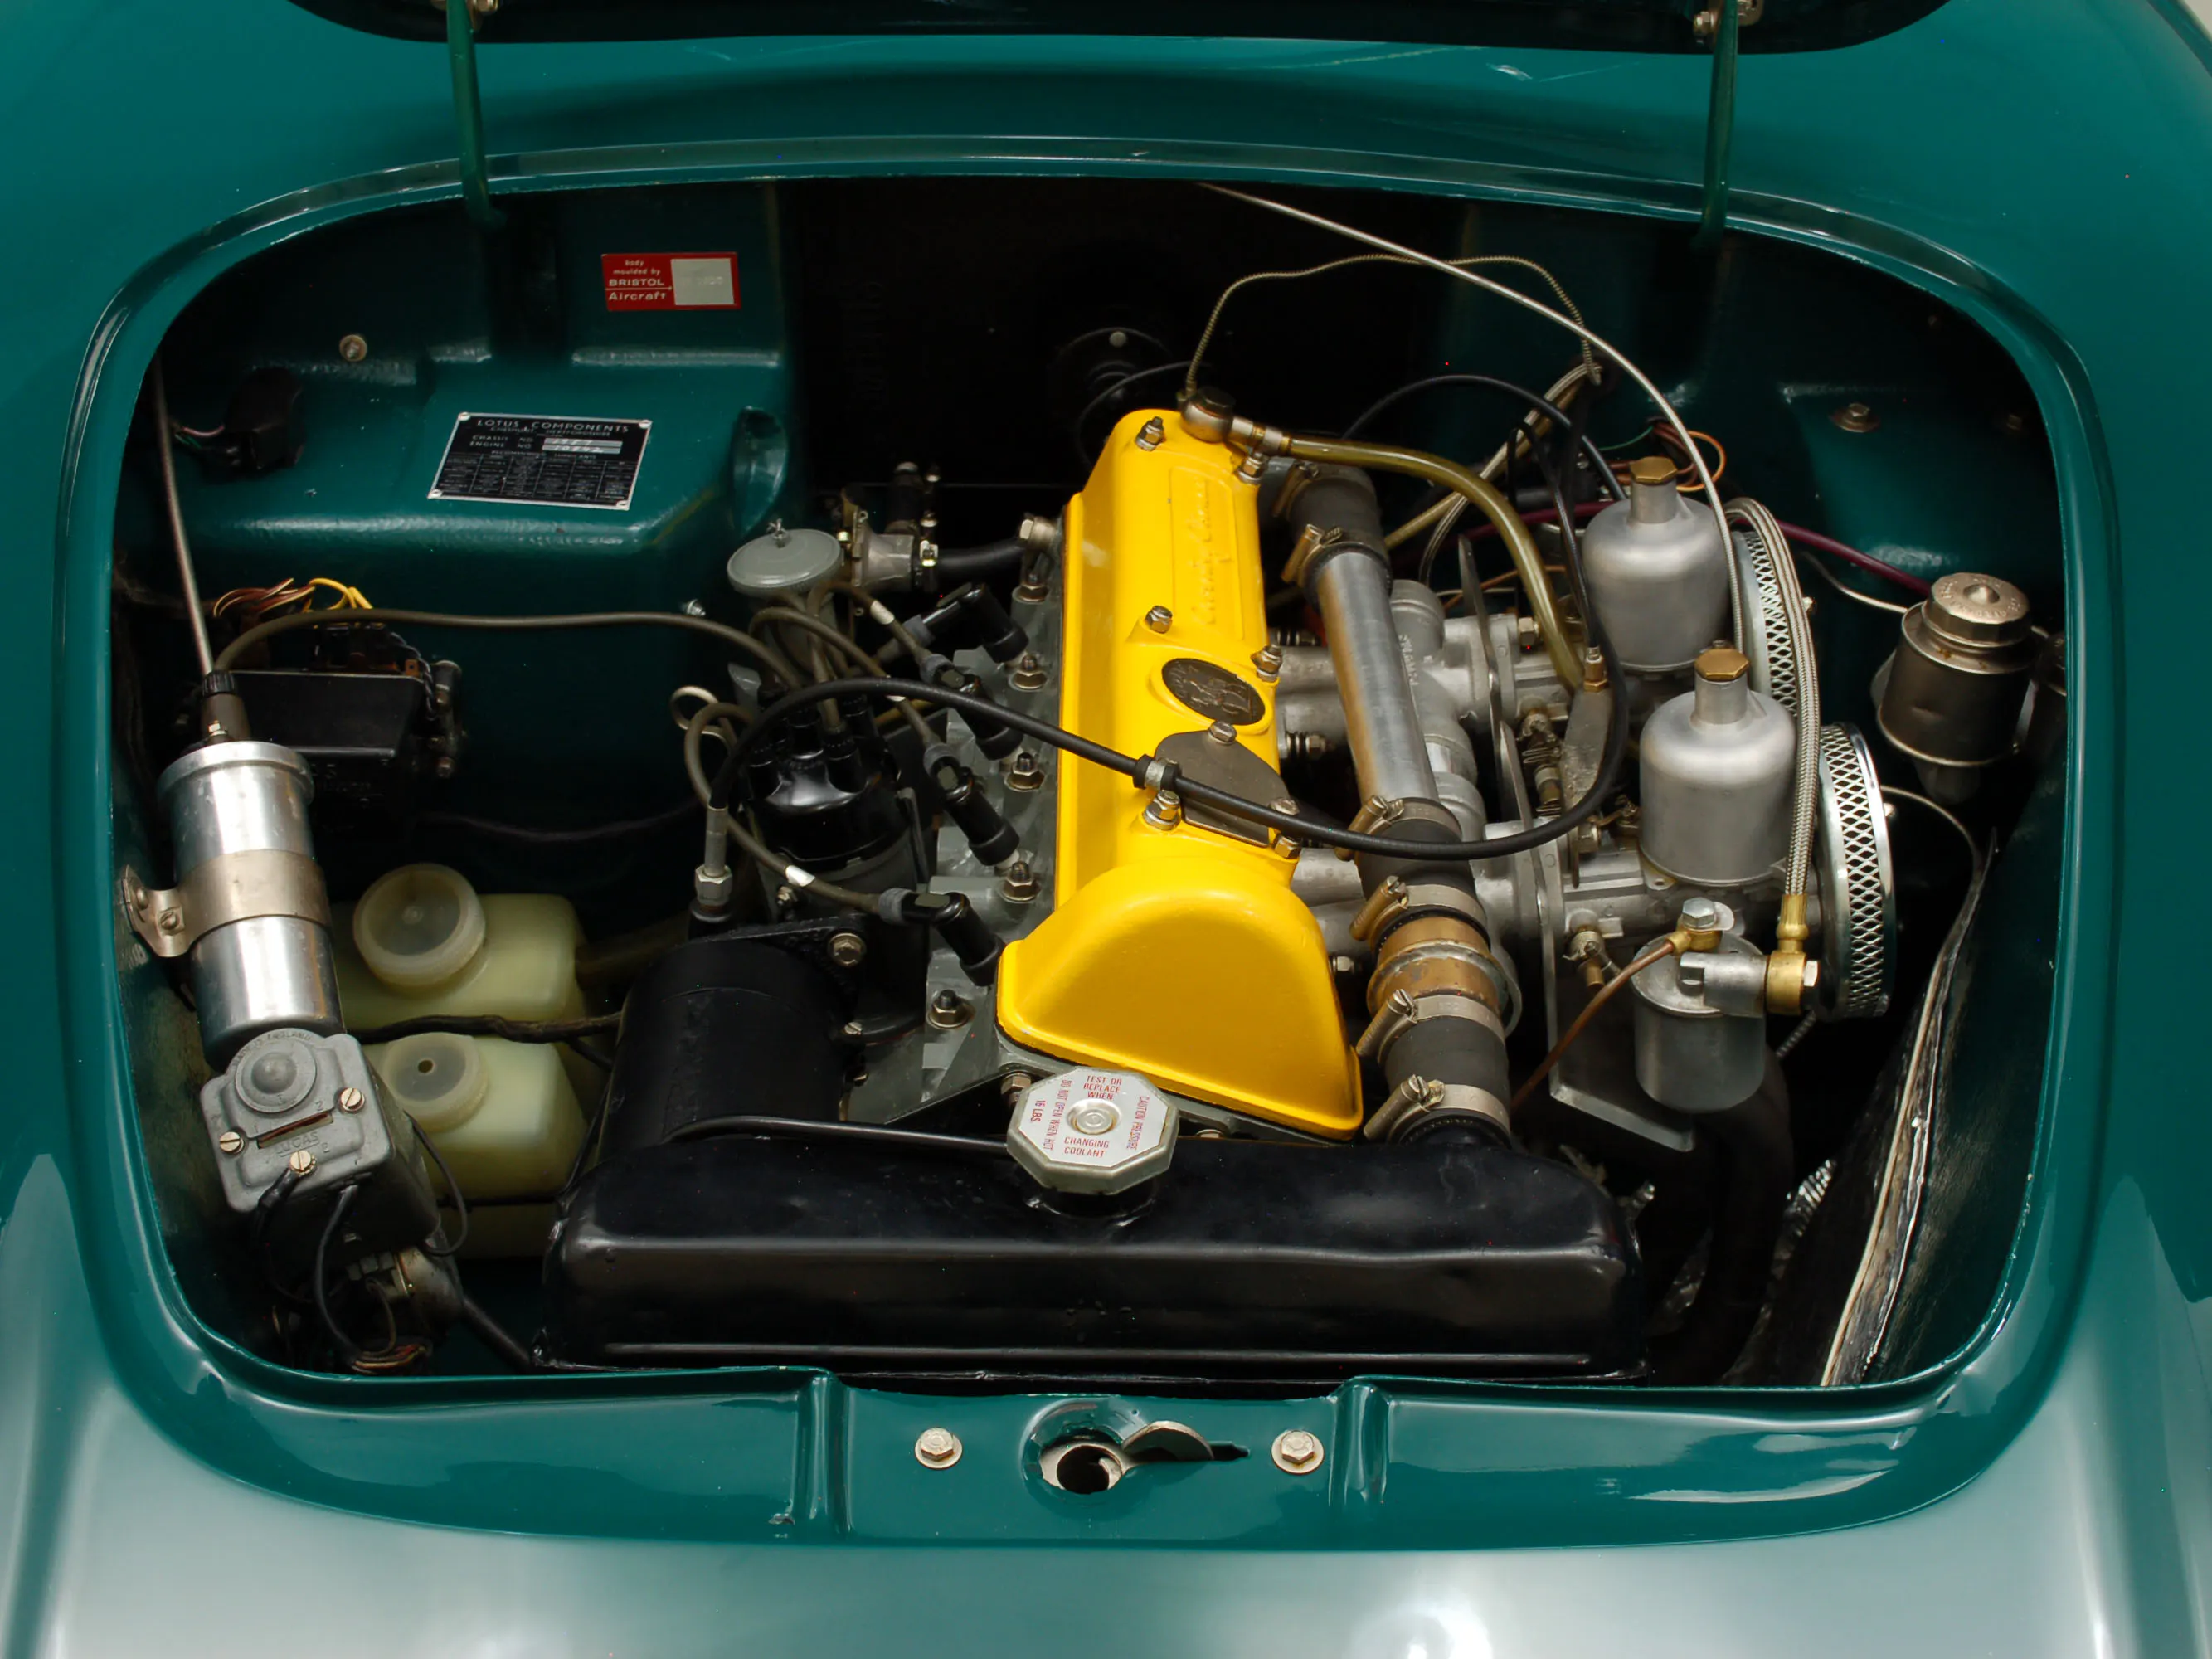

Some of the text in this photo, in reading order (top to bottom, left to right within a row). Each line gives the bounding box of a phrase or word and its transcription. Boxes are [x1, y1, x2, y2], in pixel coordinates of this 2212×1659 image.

[650, 267, 661, 276] by
[609, 291, 666, 301] Aircraft
[477, 419, 630, 432] LOTUS COMPONENTS
[1087, 1075, 1122, 1086] TEST OR
[1083, 1082, 1121, 1093] REPLACE
[1057, 1089, 1069, 1101] NOT
[1087, 1091, 1115, 1101] WHEN
[1052, 1102, 1066, 1117] OPEN
[1135, 1096, 1150, 1120] CAUTION
[1046, 1119, 1060, 1136] WHEN
[277, 1131, 318, 1154] LUCAS
[1064, 1136, 1110, 1148] CHANGING
[1064, 1146, 1106, 1157] COOLANT
